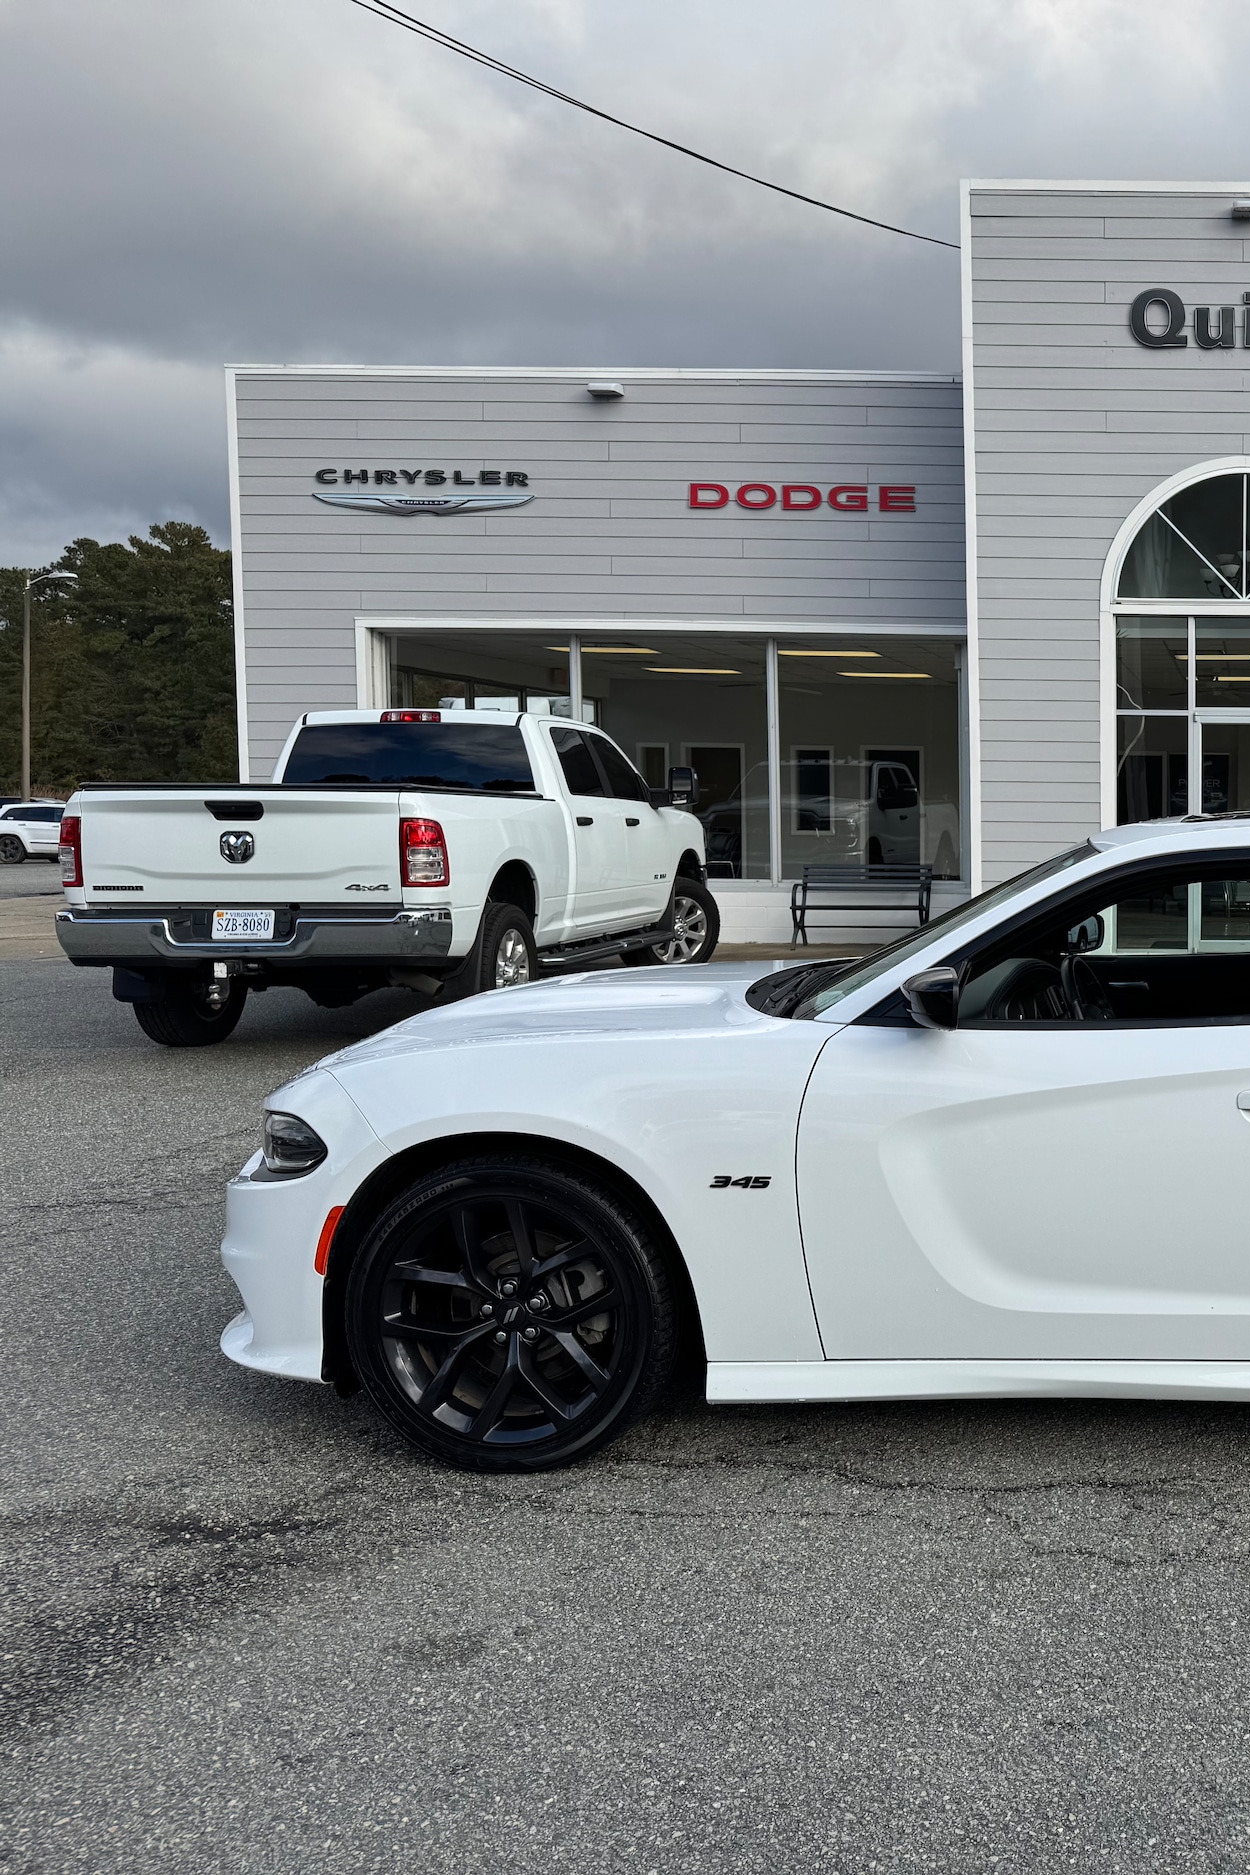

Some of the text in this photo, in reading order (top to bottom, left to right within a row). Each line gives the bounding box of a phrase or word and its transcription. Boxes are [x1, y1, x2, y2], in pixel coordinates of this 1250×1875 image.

[315, 469, 529, 487] CHRYSLER
[689, 483, 917, 512] DODGE
[1178, 778, 1221, 788] PER
[216, 918, 270, 932] SZB-8080
[709, 1175, 772, 1189] 345
